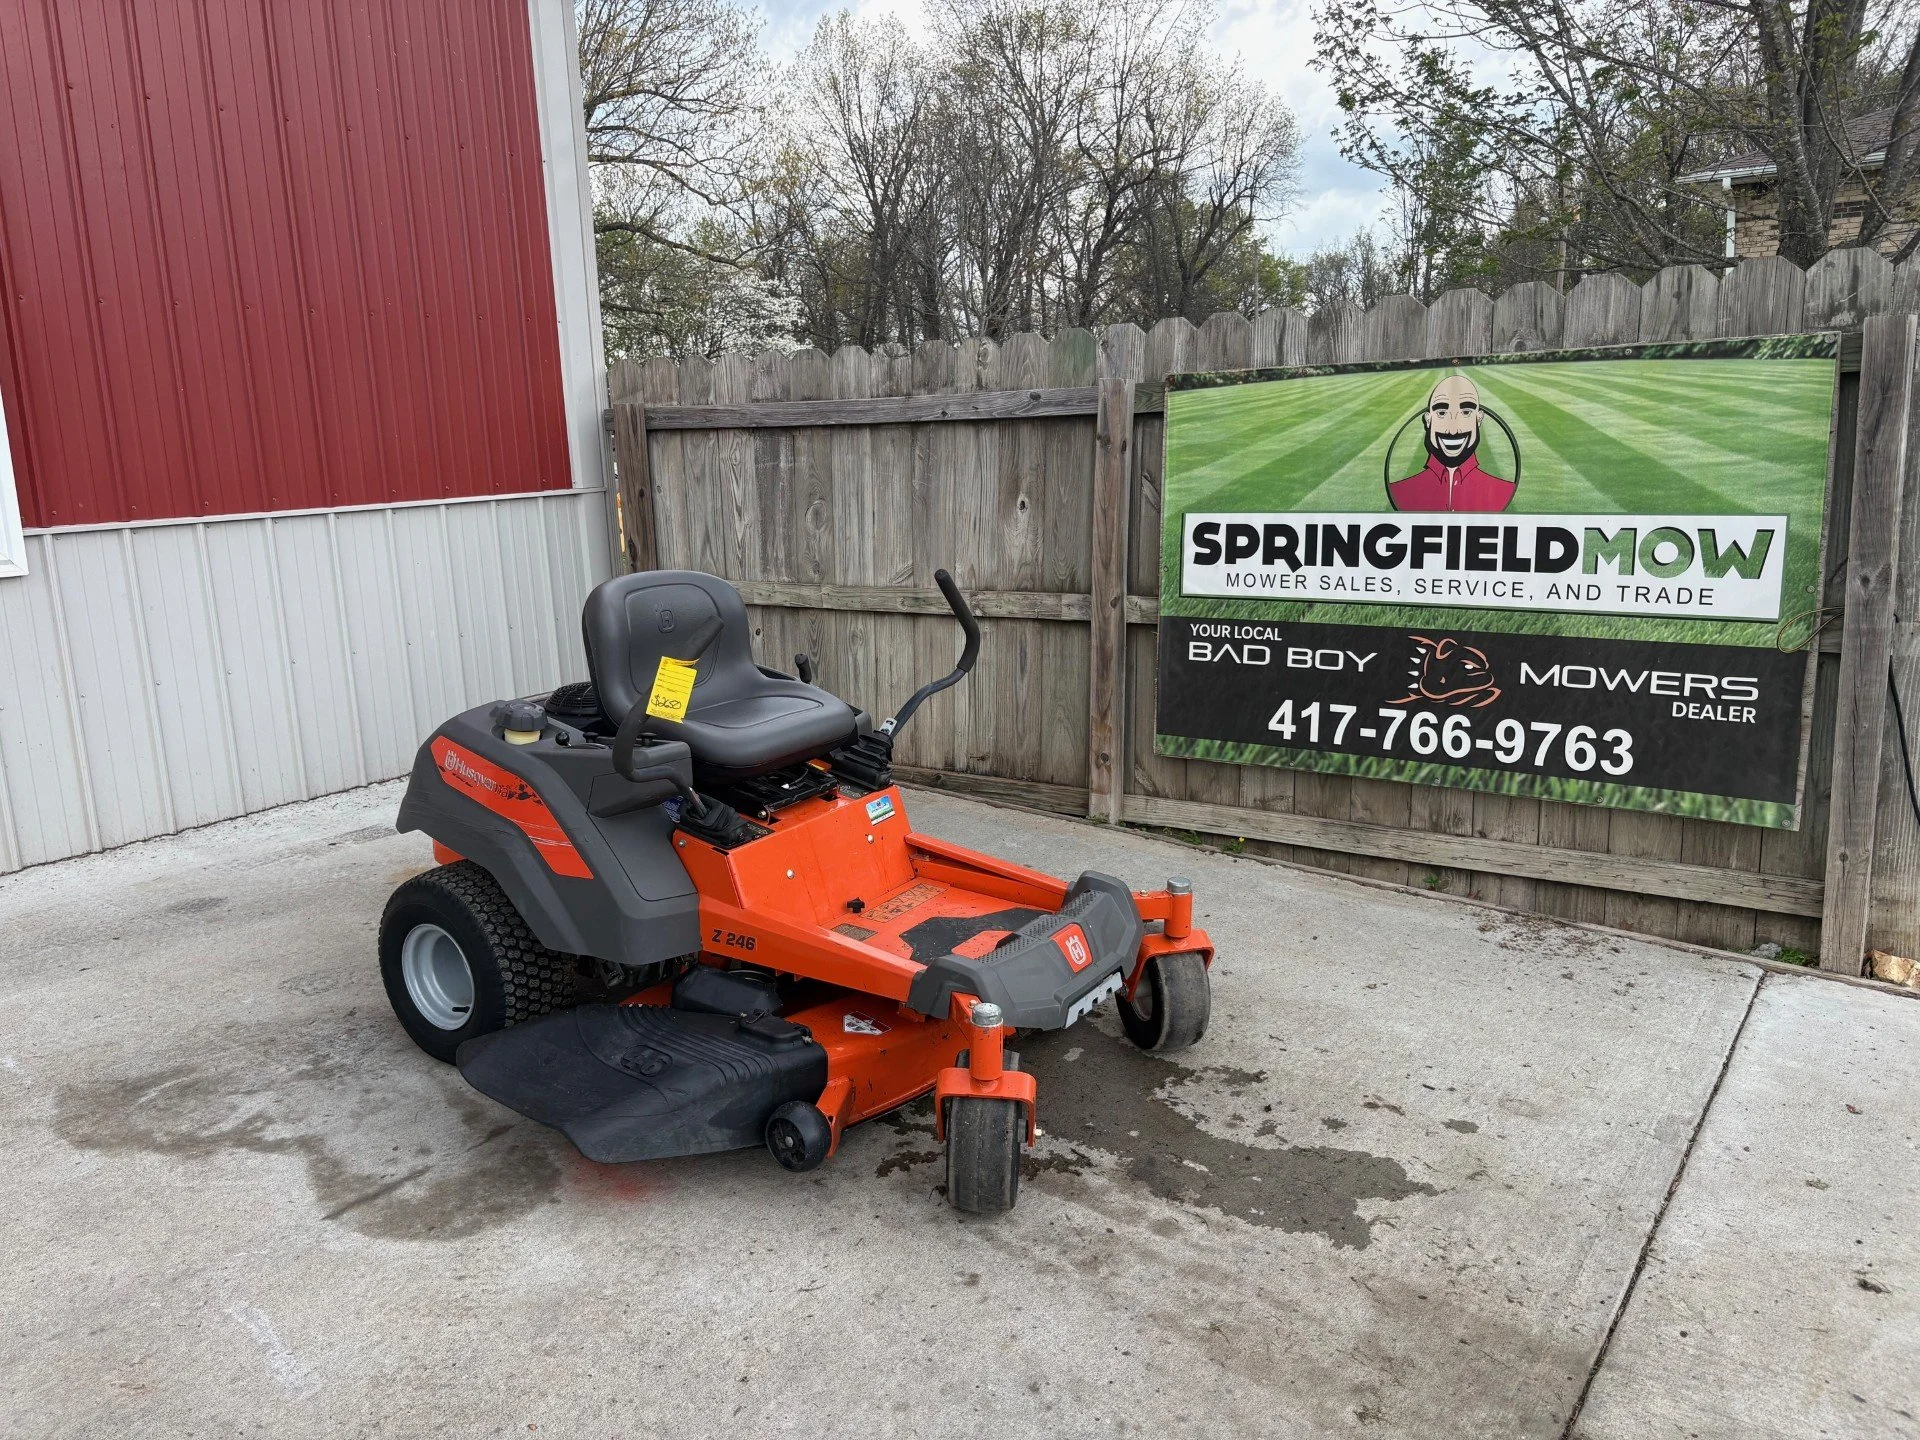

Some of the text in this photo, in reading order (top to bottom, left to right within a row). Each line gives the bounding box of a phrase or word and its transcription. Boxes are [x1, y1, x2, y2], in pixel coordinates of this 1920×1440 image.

[1226, 572, 1714, 606] MOWER SALES, SERVICE, AND TRADE
[1190, 623, 1282, 641] YOUR LOCAL
[1188, 641, 1378, 673] BAD BOY
[1520, 662, 1759, 701] MOWERS
[1671, 701, 1757, 724] DEALER
[1268, 699, 1634, 776] 417-766-9763
[454, 757, 510, 799] Husqvarna
[711, 929, 756, 951] Z 246
